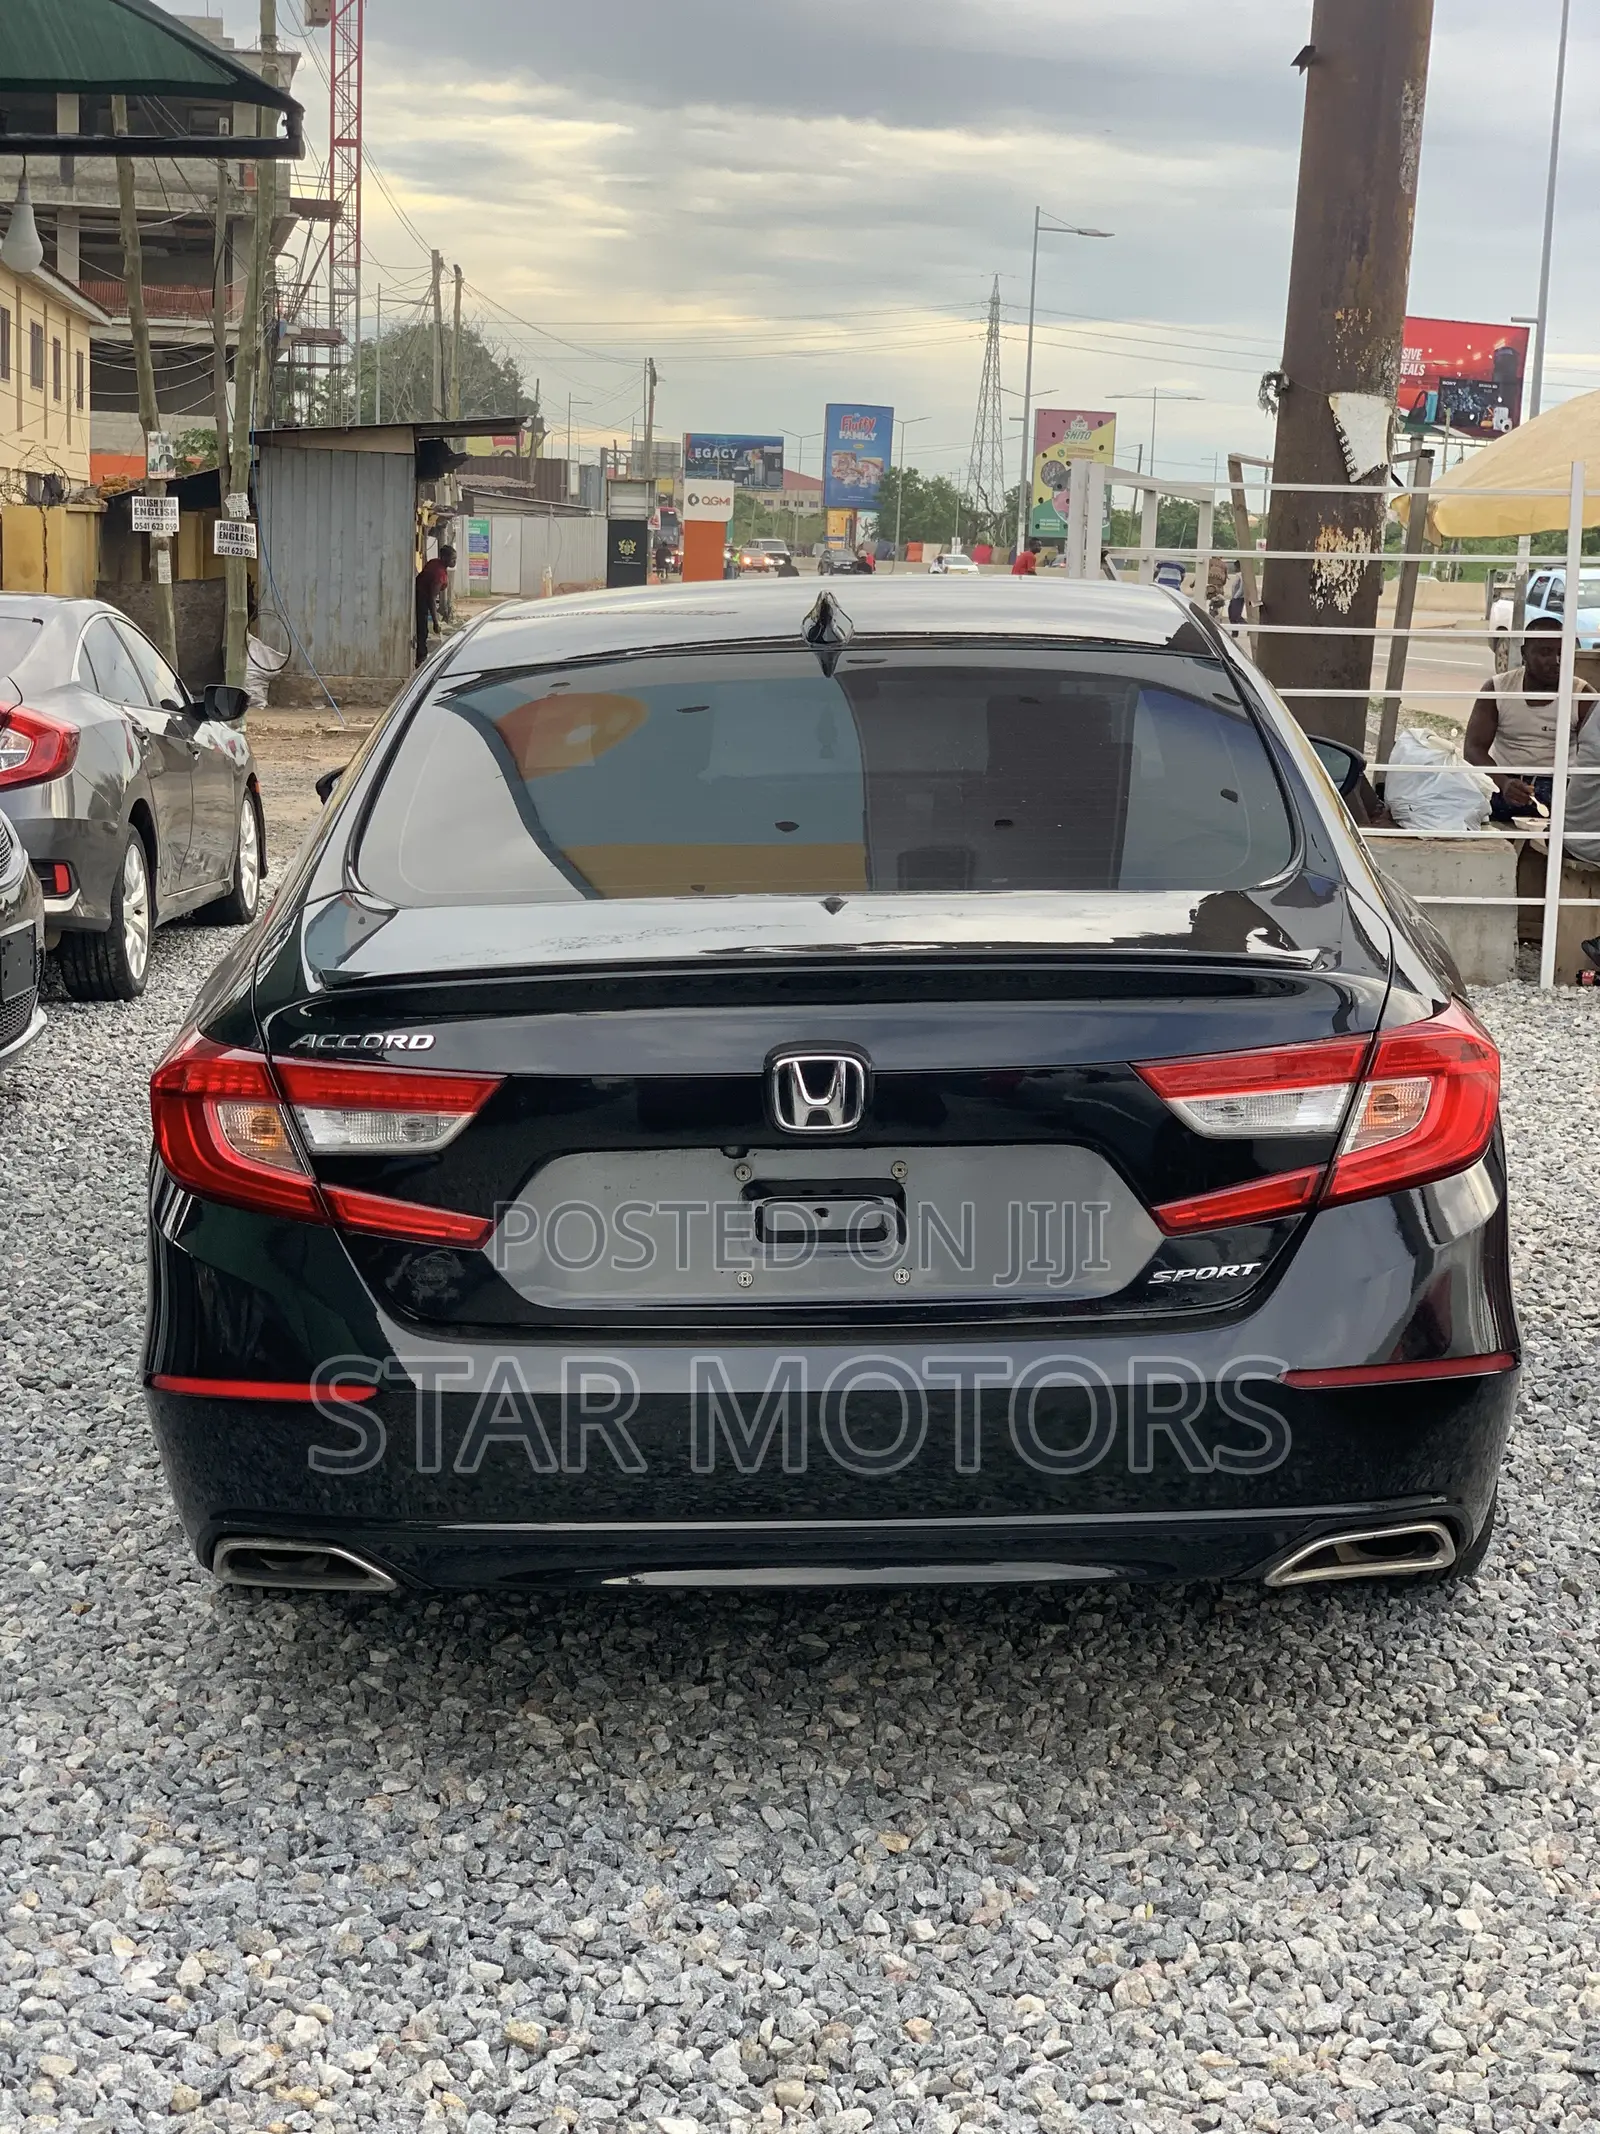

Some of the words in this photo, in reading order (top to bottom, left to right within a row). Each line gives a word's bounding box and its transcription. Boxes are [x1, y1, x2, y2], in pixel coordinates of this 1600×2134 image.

[838, 430, 878, 441] FAMILY
[1064, 430, 1093, 441] SHITO
[688, 447, 738, 459] LEGACY
[134, 498, 159, 507] POLISH
[159, 499, 177, 508] YOUR
[134, 507, 177, 516] ENGLISH
[134, 522, 150, 530] 0541
[151, 523, 164, 531] 623
[165, 523, 178, 531] 059
[219, 522, 240, 533] POLISH
[219, 531, 255, 544] ENGLISH
[231, 547, 243, 556] 623
[244, 548, 256, 557] 059
[289, 1033, 436, 1051] ACCORD
[1147, 1262, 1262, 1285] SPORT
